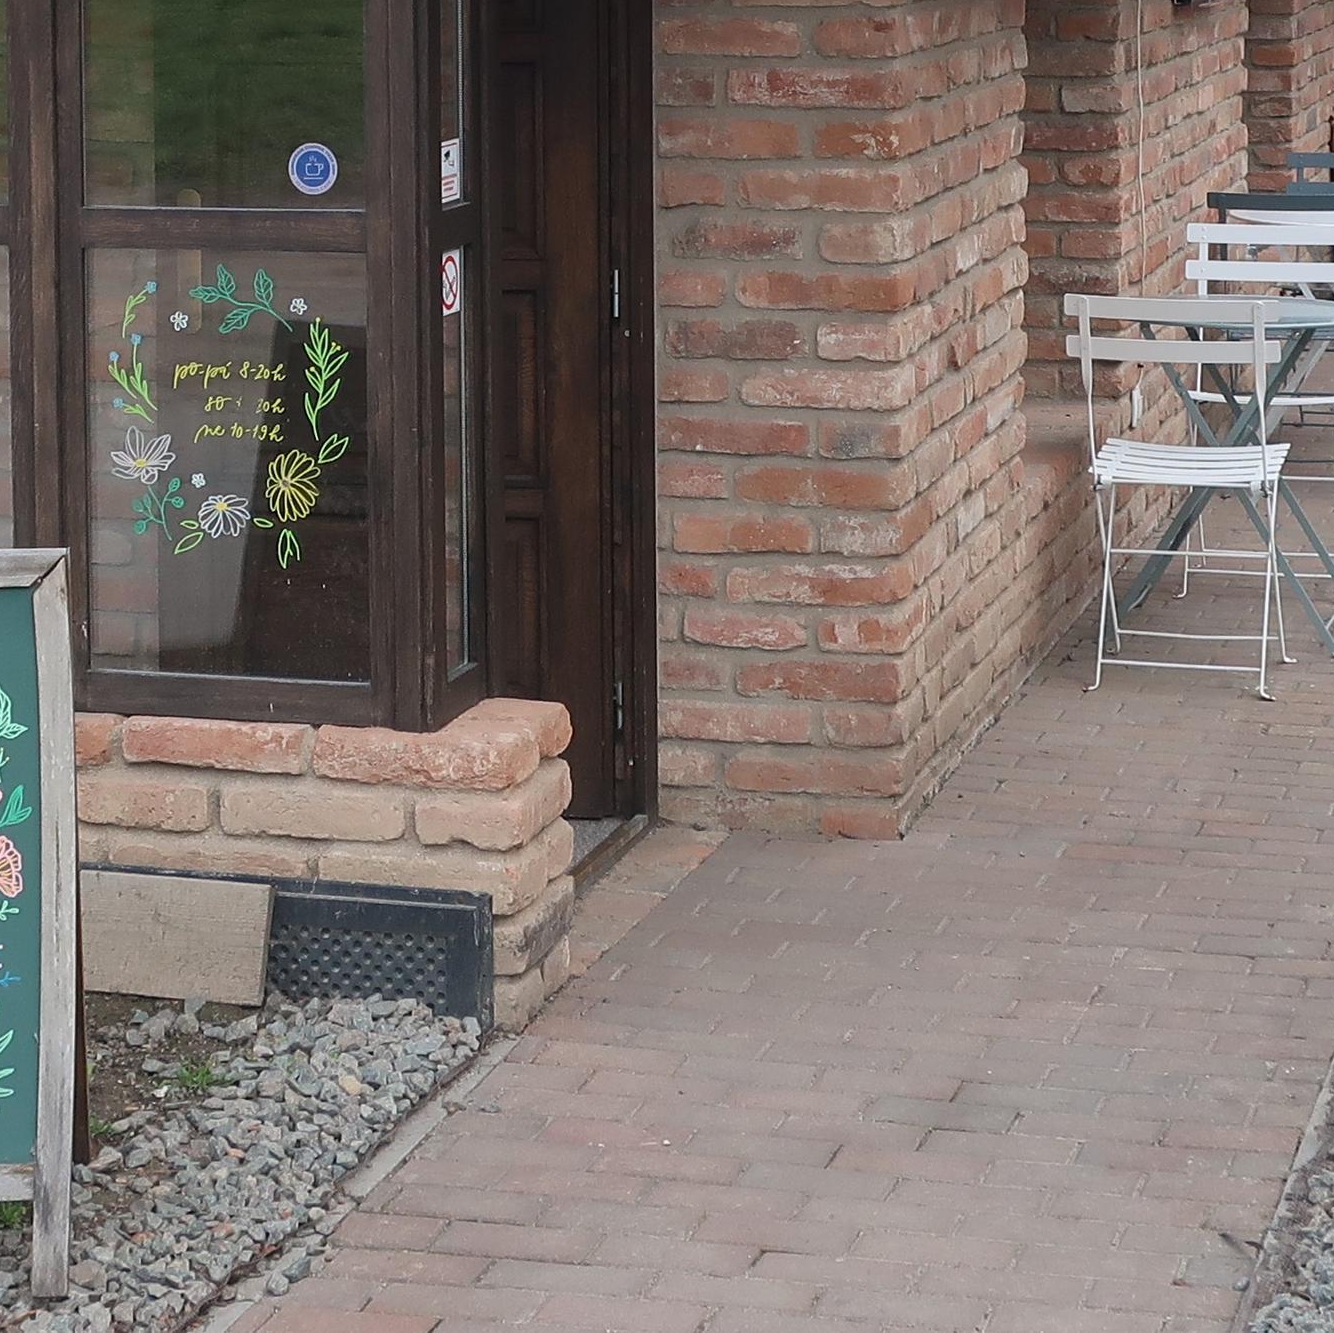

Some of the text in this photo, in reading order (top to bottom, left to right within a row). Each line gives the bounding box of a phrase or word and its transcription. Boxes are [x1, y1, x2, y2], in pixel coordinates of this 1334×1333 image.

[238, 361, 287, 382] 8-20h
[204, 395, 232, 412] so
[194, 422, 284, 443] ne 10-19h
